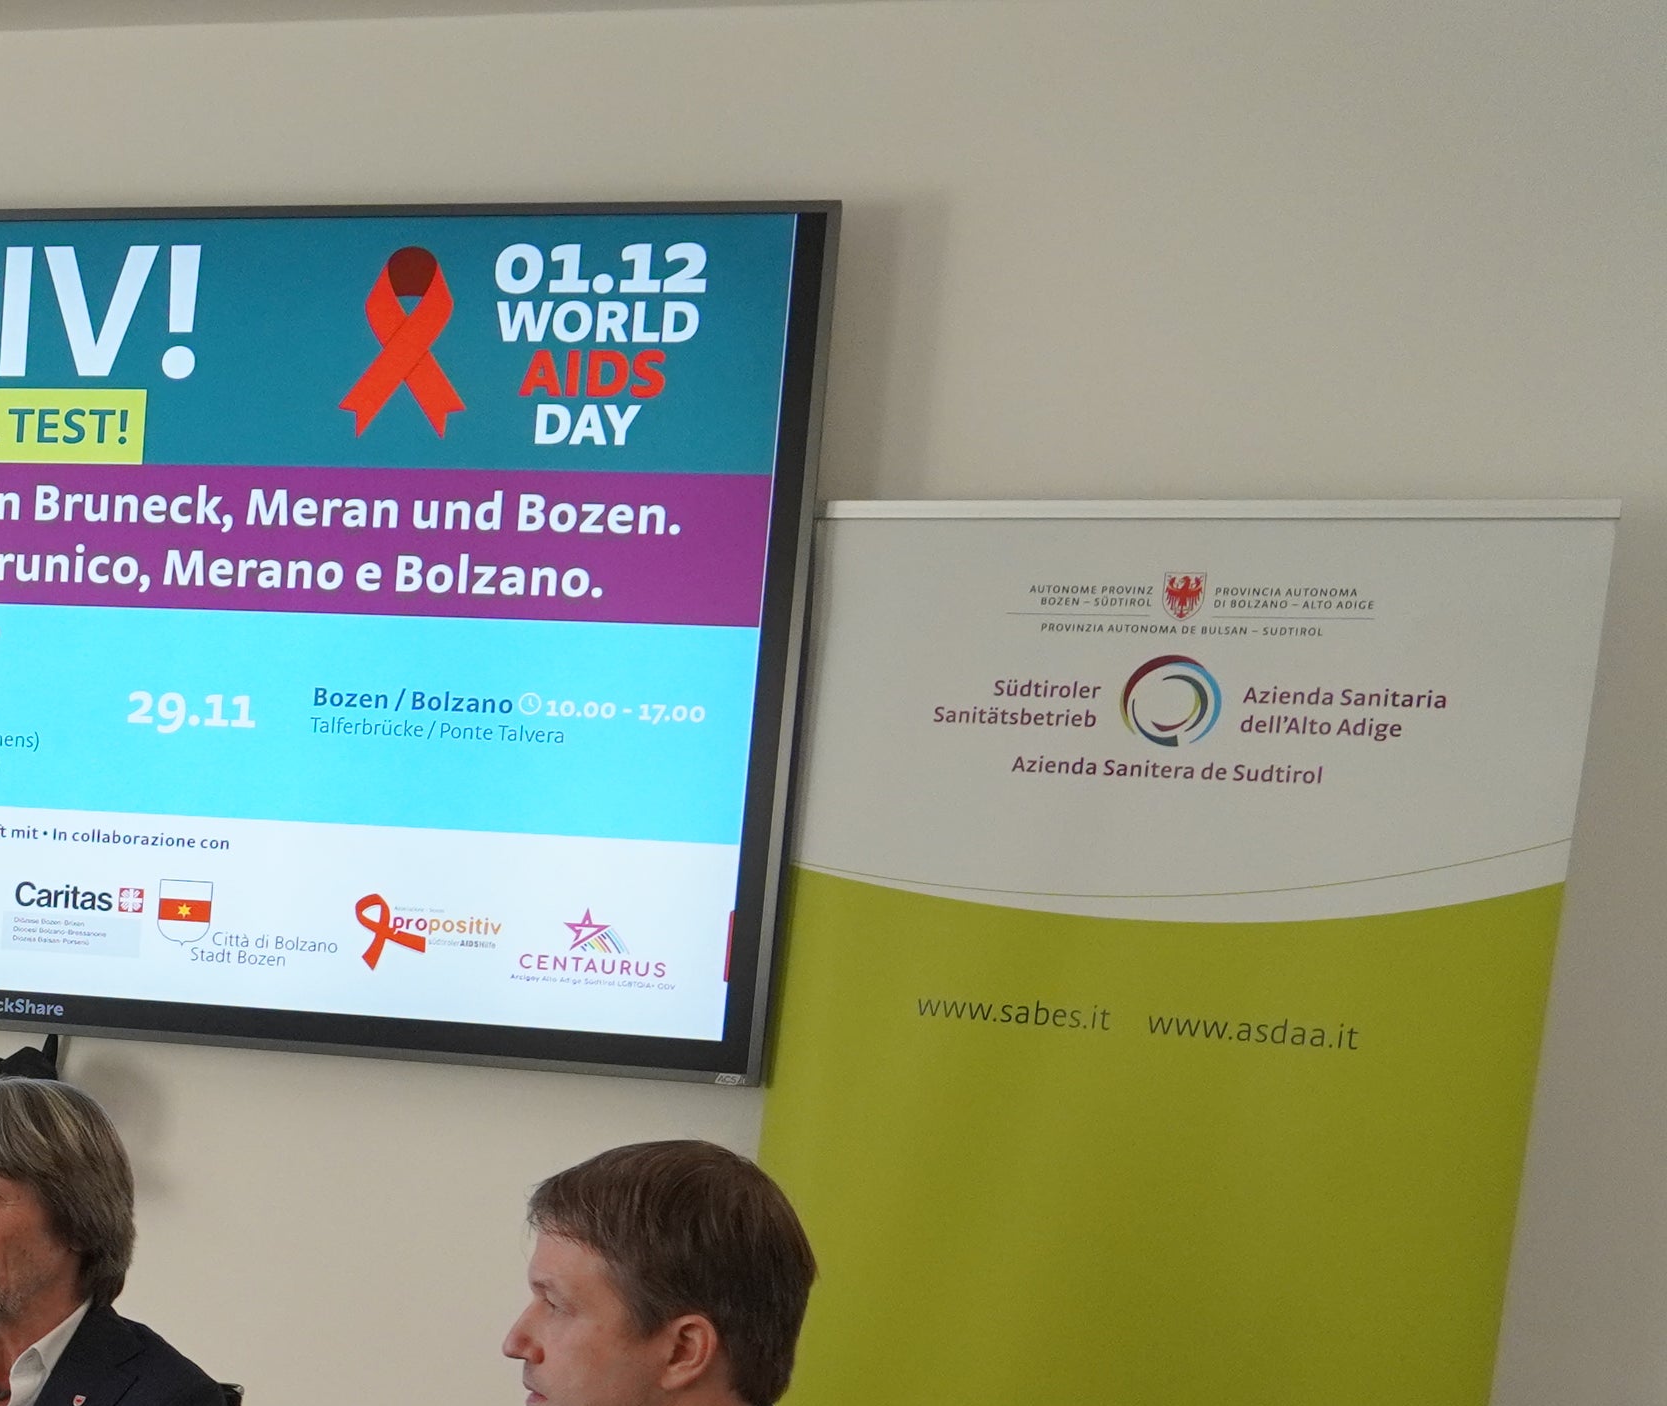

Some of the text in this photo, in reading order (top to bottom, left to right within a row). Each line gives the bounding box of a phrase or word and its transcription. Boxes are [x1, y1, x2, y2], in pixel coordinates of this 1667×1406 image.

[495, 242, 708, 295] 01.12
[497, 300, 701, 345] WORLD
[519, 349, 666, 400] AIDS
[8, 408, 130, 445] TEST!
[535, 403, 641, 446] DAY
[34, 483, 234, 533] Bruneck,
[247, 486, 399, 529] Meran
[412, 488, 504, 531] und
[518, 492, 682, 536] Bozen.
[162, 548, 345, 591] Merano
[355, 562, 381, 592] e
[395, 553, 605, 598] Bolzano.
[1029, 584, 1154, 596] AUTONOME PROVINZ
[1040, 595, 1153, 607] BOZEN SÜDTIROL
[1214, 587, 1358, 598] PROVINCIA AUTONOMA
[1214, 600, 1374, 611] DI BOLZANO ALTO ADIGE
[1040, 623, 1324, 638] PROVINZIA AUTONOMA DE BULSAN SUDTIROL
[993, 679, 1102, 700] Südtiroler
[1243, 686, 1448, 710] Azienda Sanitaria
[127, 690, 257, 733] 29.11
[313, 687, 706, 725] Bozen Bolzano 10.00 17.00
[933, 706, 1098, 729] Sanitätsbetrieb
[310, 716, 565, 745] Talferbrücke Ponte Talvera
[1337, 718, 1403, 743] Adige
[1011, 756, 1324, 786] Azienda Sanitera de Sudtirol
[11, 826, 40, 841] mit
[52, 828, 68, 842] In
[72, 829, 196, 850] collaborazione
[200, 836, 230, 851] con
[14, 880, 114, 912] Caritas
[211, 930, 339, 956] Città di Bolzano
[189, 947, 288, 969] Stadt Bozen
[519, 953, 667, 979] CENTAURUS
[917, 998, 1359, 1051] www.sabes.it www.asdaa.it
